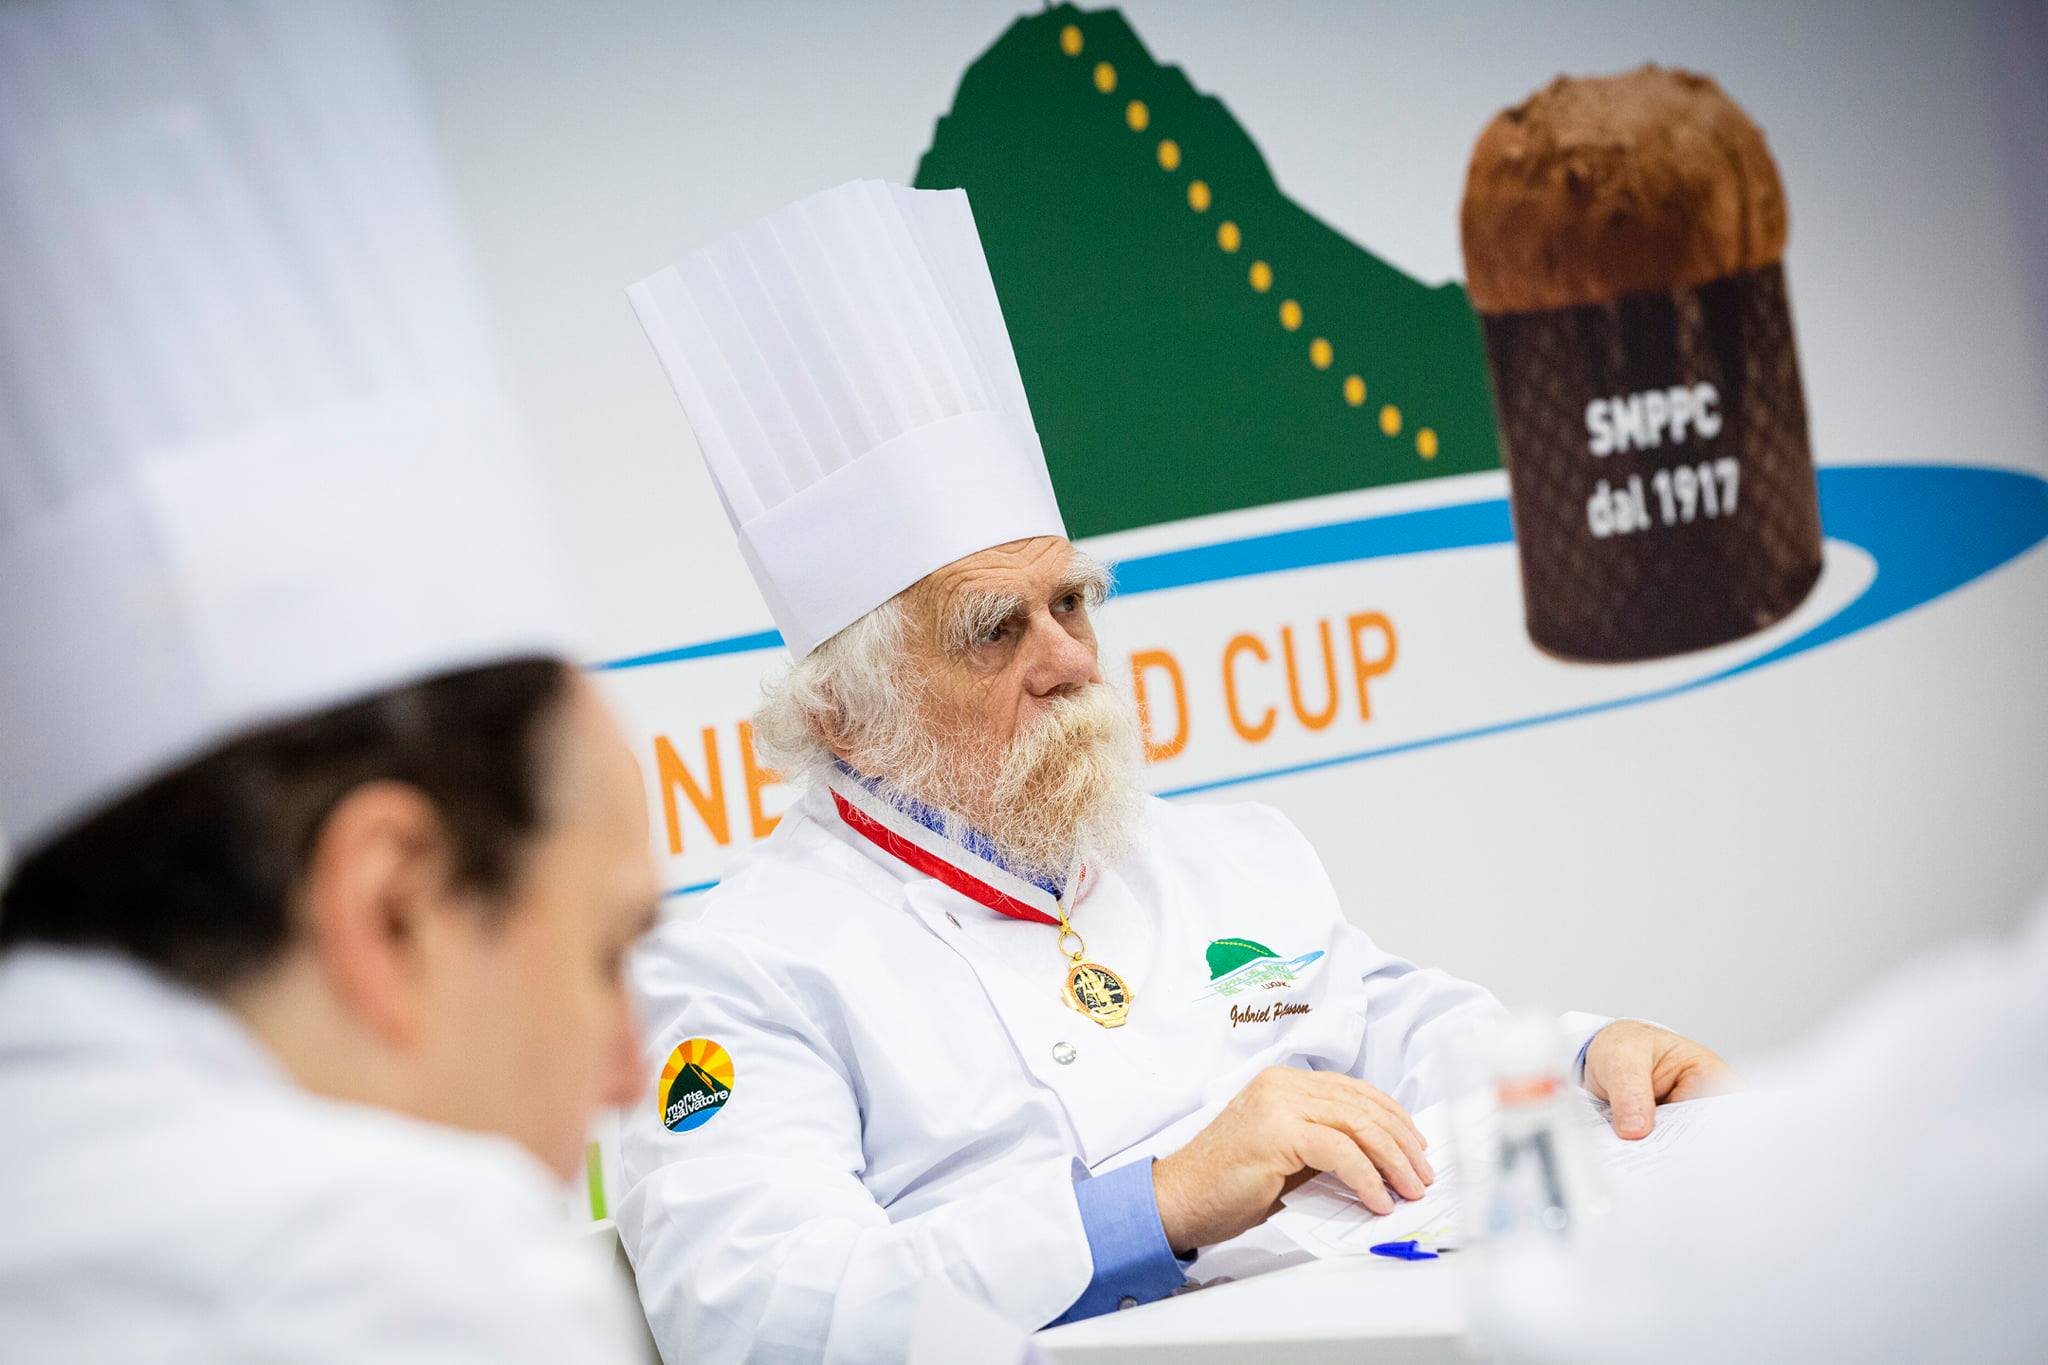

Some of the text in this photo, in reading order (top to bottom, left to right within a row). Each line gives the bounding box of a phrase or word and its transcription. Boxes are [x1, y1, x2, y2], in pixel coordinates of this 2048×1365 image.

[1585, 382, 1722, 457] SMPPC
[1587, 457, 1740, 538] dal 1917
[1224, 611, 1399, 743] CUP
[1230, 1004, 1271, 1028] Gabriel
[667, 1090, 704, 1116] monte
